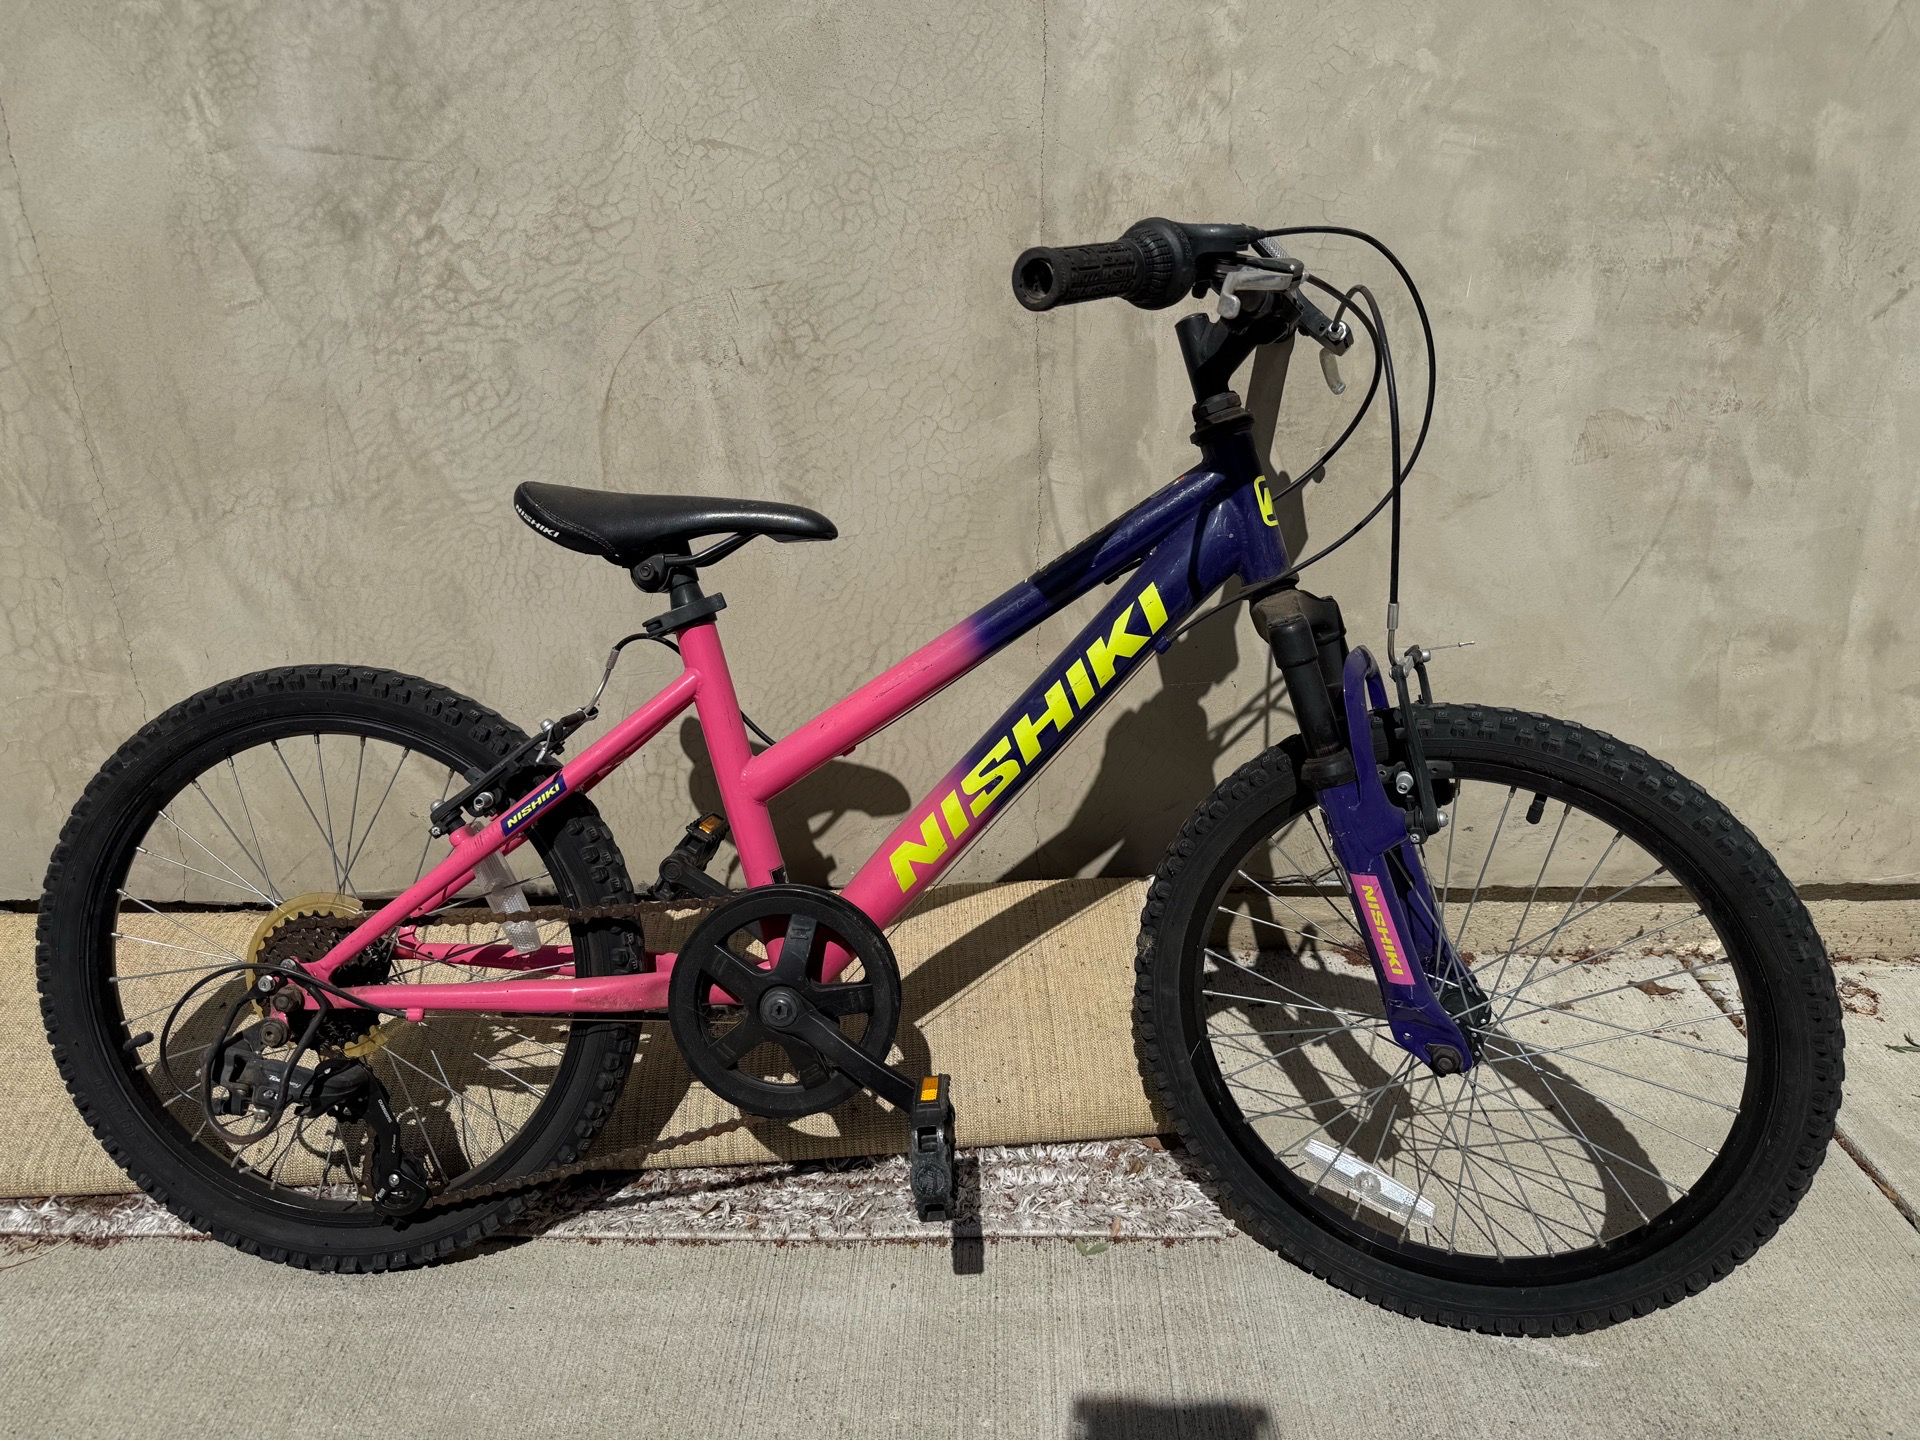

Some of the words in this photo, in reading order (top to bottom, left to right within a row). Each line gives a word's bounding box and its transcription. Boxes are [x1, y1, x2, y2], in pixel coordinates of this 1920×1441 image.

[515, 504, 560, 538] NISHIKI
[889, 582, 1169, 893] NISHIKI
[507, 783, 560, 828] NISHIKI
[1361, 885, 1404, 976] NISHIKI
